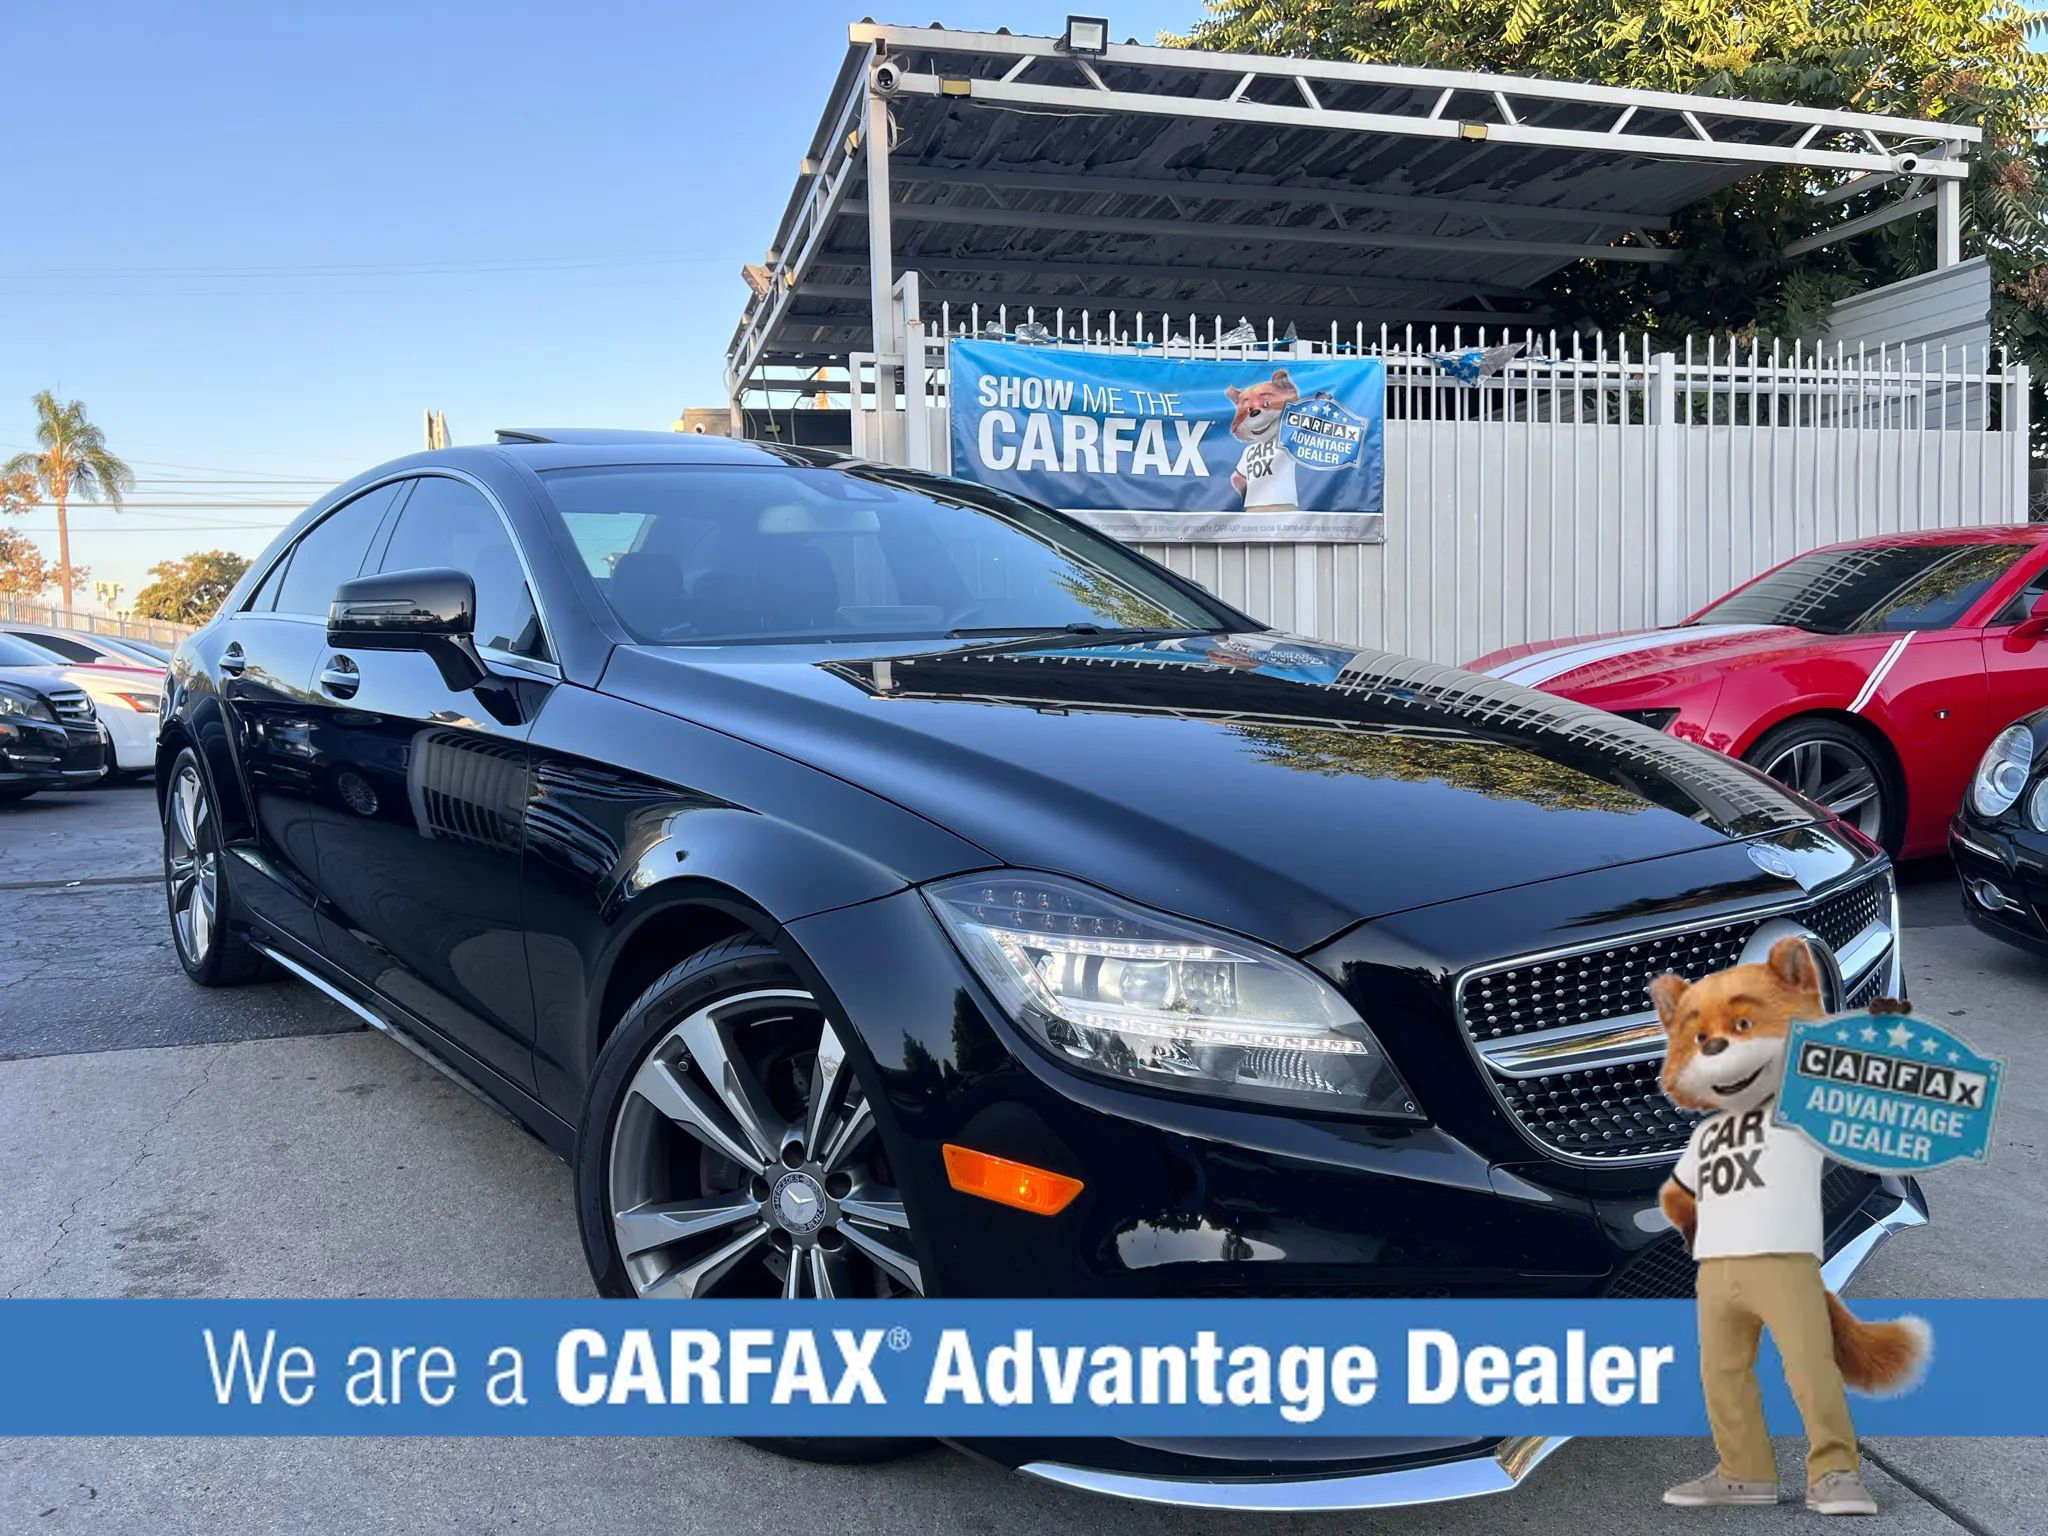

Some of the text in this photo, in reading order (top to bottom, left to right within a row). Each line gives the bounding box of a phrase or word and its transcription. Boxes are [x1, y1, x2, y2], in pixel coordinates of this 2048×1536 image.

[978, 374, 1184, 417] SHOW ME THE
[1287, 413, 1359, 441] CARFAX
[978, 410, 1212, 477] CARFAX
[1246, 440, 1274, 461] CAR
[1290, 431, 1352, 454] ADVANTAGE
[1297, 446, 1340, 465] DEALER
[1246, 458, 1273, 481] FOX
